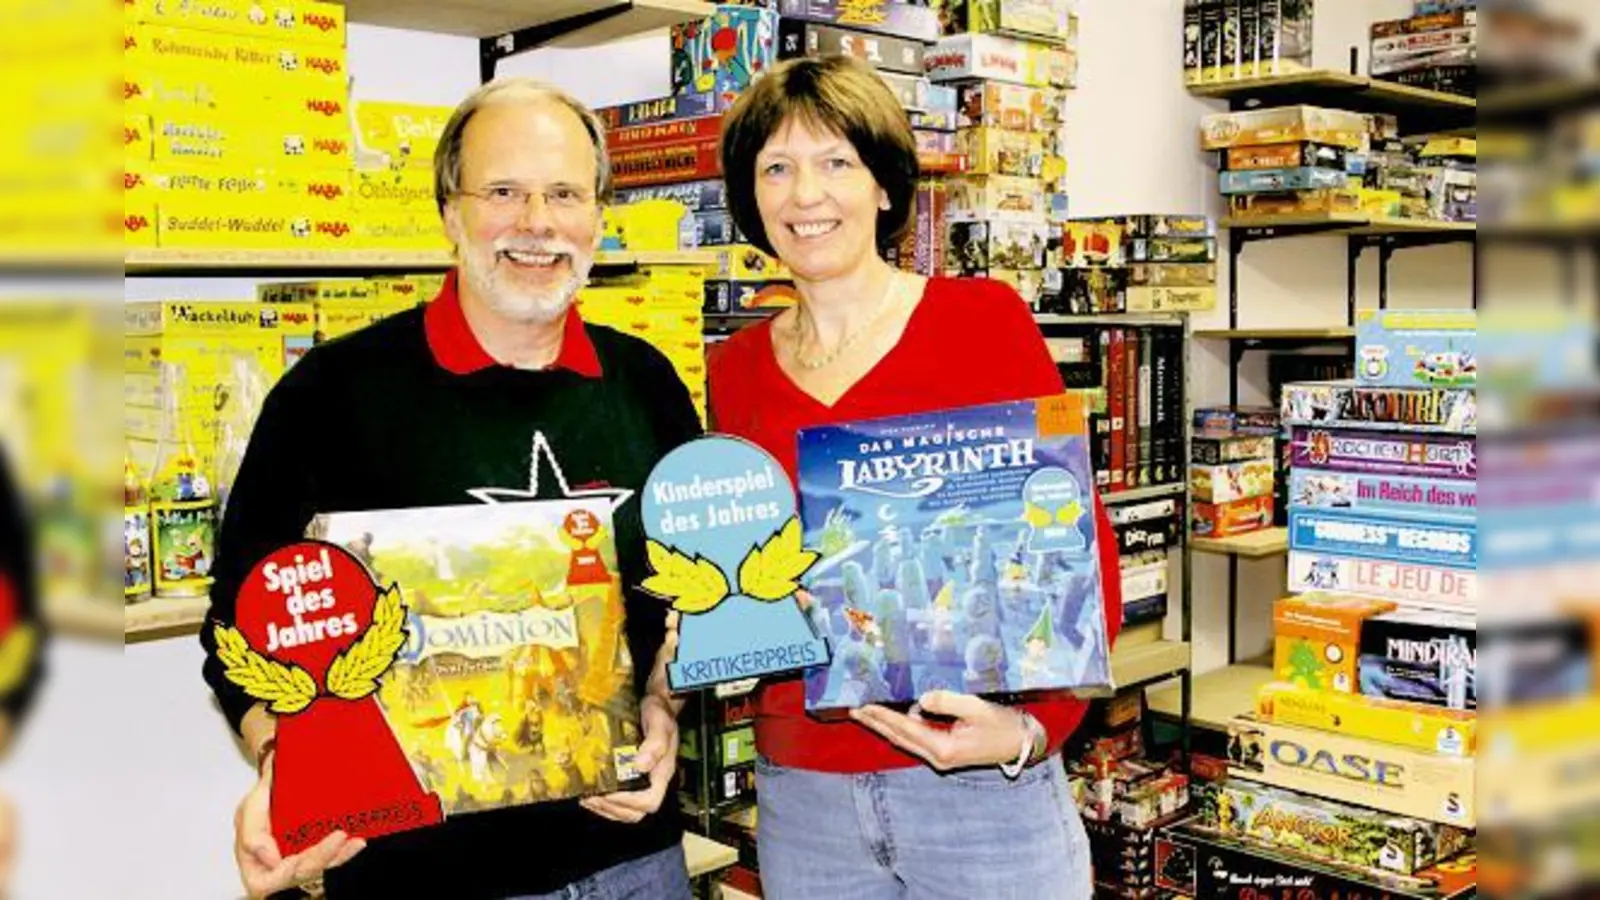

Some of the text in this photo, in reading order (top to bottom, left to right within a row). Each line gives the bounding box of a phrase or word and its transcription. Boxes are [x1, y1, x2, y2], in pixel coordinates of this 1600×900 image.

[303, 14, 336, 32] HABA
[305, 57, 341, 75] HABA
[306, 99, 342, 116] HABA
[313, 139, 346, 155] HABA
[307, 183, 343, 200] HABA
[316, 221, 350, 238] HABA
[281, 312, 309, 326] HABA
[860, 423, 1005, 454] DAS MAGISCHE
[837, 437, 1038, 498] LABYRINTH
[653, 465, 775, 505] Kinderspiel
[1379, 480, 1424, 502] Reich
[1427, 484, 1456, 504] des
[660, 500, 781, 534] des Jahres
[262, 548, 334, 594] Spiel
[1357, 560, 1468, 597] LE JEU DE
[286, 585, 336, 616] des
[266, 612, 358, 652] Jahres
[681, 641, 817, 683] KRITIKERPREIS
[1270, 740, 1405, 788] OASE
[1253, 808, 1350, 845] ANGKOR
